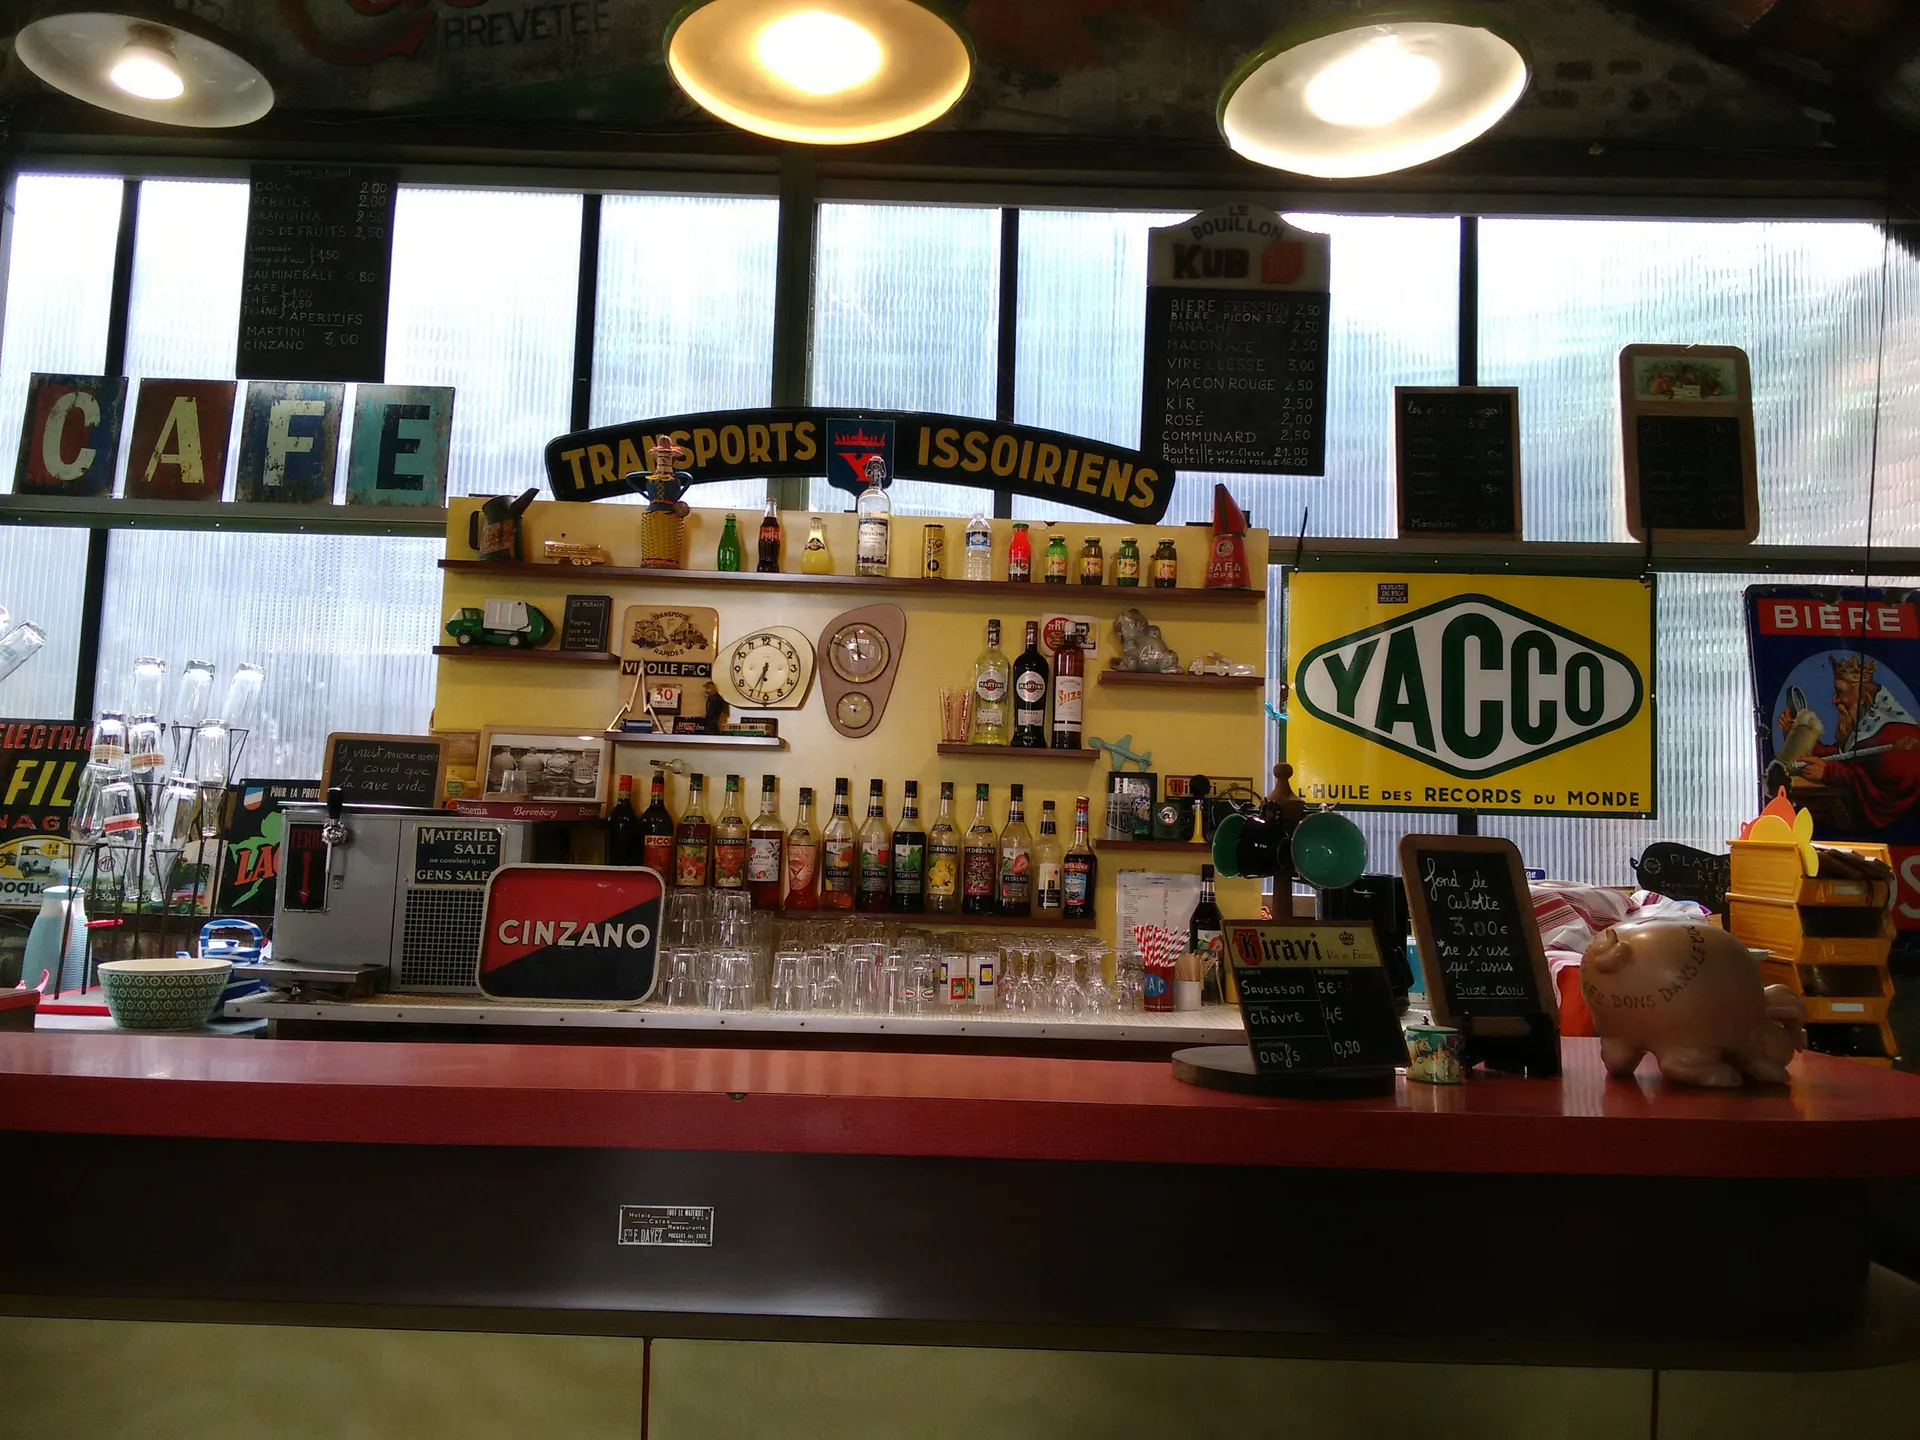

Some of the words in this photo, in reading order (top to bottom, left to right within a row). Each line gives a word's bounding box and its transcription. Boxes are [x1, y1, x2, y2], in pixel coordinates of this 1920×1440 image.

[254, 181, 293, 192] COCA
[252, 196, 311, 208] PERRIER
[250, 211, 321, 222] ORANGINA
[1228, 205, 1248, 216] LE
[248, 226, 275, 236] JUS
[280, 226, 294, 236] DE
[298, 225, 346, 238] FRUITS
[354, 226, 384, 240] 2,50
[1190, 217, 1285, 240] BOUILLON
[248, 241, 292, 252] Limonade
[247, 269, 268, 280] EAU
[271, 270, 334, 282] MINERALE
[244, 283, 277, 292] CAFE
[1223, 301, 1291, 316] PRESSION
[1295, 303, 1320, 318] 2,50
[1223, 312, 1262, 323] PICON
[246, 326, 306, 337] MARTINI
[1291, 321, 1320, 335] 2,50
[243, 339, 304, 350] CINZANO
[323, 331, 359, 348] 3,00
[1288, 339, 1318, 354] 2,50
[1166, 357, 1202, 370] VIRE
[1288, 360, 1315, 374] 3,00
[1165, 377, 1225, 391] MACON
[1228, 377, 1277, 391] ROUGE
[1283, 379, 1314, 393] 2,50
[1165, 397, 1195, 411] KIR
[1282, 397, 1313, 412] 2,50
[1164, 410, 1204, 427] ROSÉ
[1280, 411, 1312, 428] 2,00
[1161, 430, 1258, 444] COMMUNARD
[1279, 428, 1311, 442] 2,50
[1162, 442, 1213, 456] Bouteille
[917, 426, 1159, 508] ISSOIRIENS
[748, 642, 755, 650] 11
[762, 637, 771, 646] 12
[777, 642, 782, 650] 1
[653, 648, 685, 658] RAPIDES
[738, 651, 747, 660] 10
[786, 651, 794, 660] 2
[625, 662, 680, 676] VIOLLE
[734, 665, 742, 674] 9
[789, 664, 797, 673] 3
[738, 679, 745, 688] 8
[786, 679, 795, 687] 4
[979, 681, 1005, 689] MARTINI
[1019, 682, 1044, 690] MARTINI
[1322, 612, 1605, 760] YACCO
[656, 687, 674, 701] 30
[748, 689, 754, 698] 7
[762, 692, 770, 701] 6
[776, 688, 784, 698] 5
[353, 744, 385, 759] vaut
[363, 762, 400, 775] covid
[404, 767, 431, 780] que
[339, 774, 354, 788] la
[361, 780, 389, 791] cave
[397, 780, 427, 792] vide
[269, 786, 288, 798] POUR
[290, 787, 298, 798] LA
[1381, 789, 1413, 802] DES
[1424, 787, 1522, 805] RECORDS
[1533, 794, 1556, 806] DU
[1567, 790, 1641, 808] MONDE
[513, 806, 559, 819] Berenburg
[453, 843, 497, 855] SALE
[439, 857, 471, 865] convient
[1669, 853, 1731, 871] PLATEA
[416, 869, 453, 881] GENS
[1424, 858, 1460, 902] fond
[1469, 870, 1489, 892] de
[1447, 892, 1501, 911] Culotte
[498, 919, 651, 950] CINZANO
[1240, 980, 1305, 996] Saucisson
[1324, 1006, 1344, 1024] 4€
[641, 1229, 663, 1243] DAYEZ
